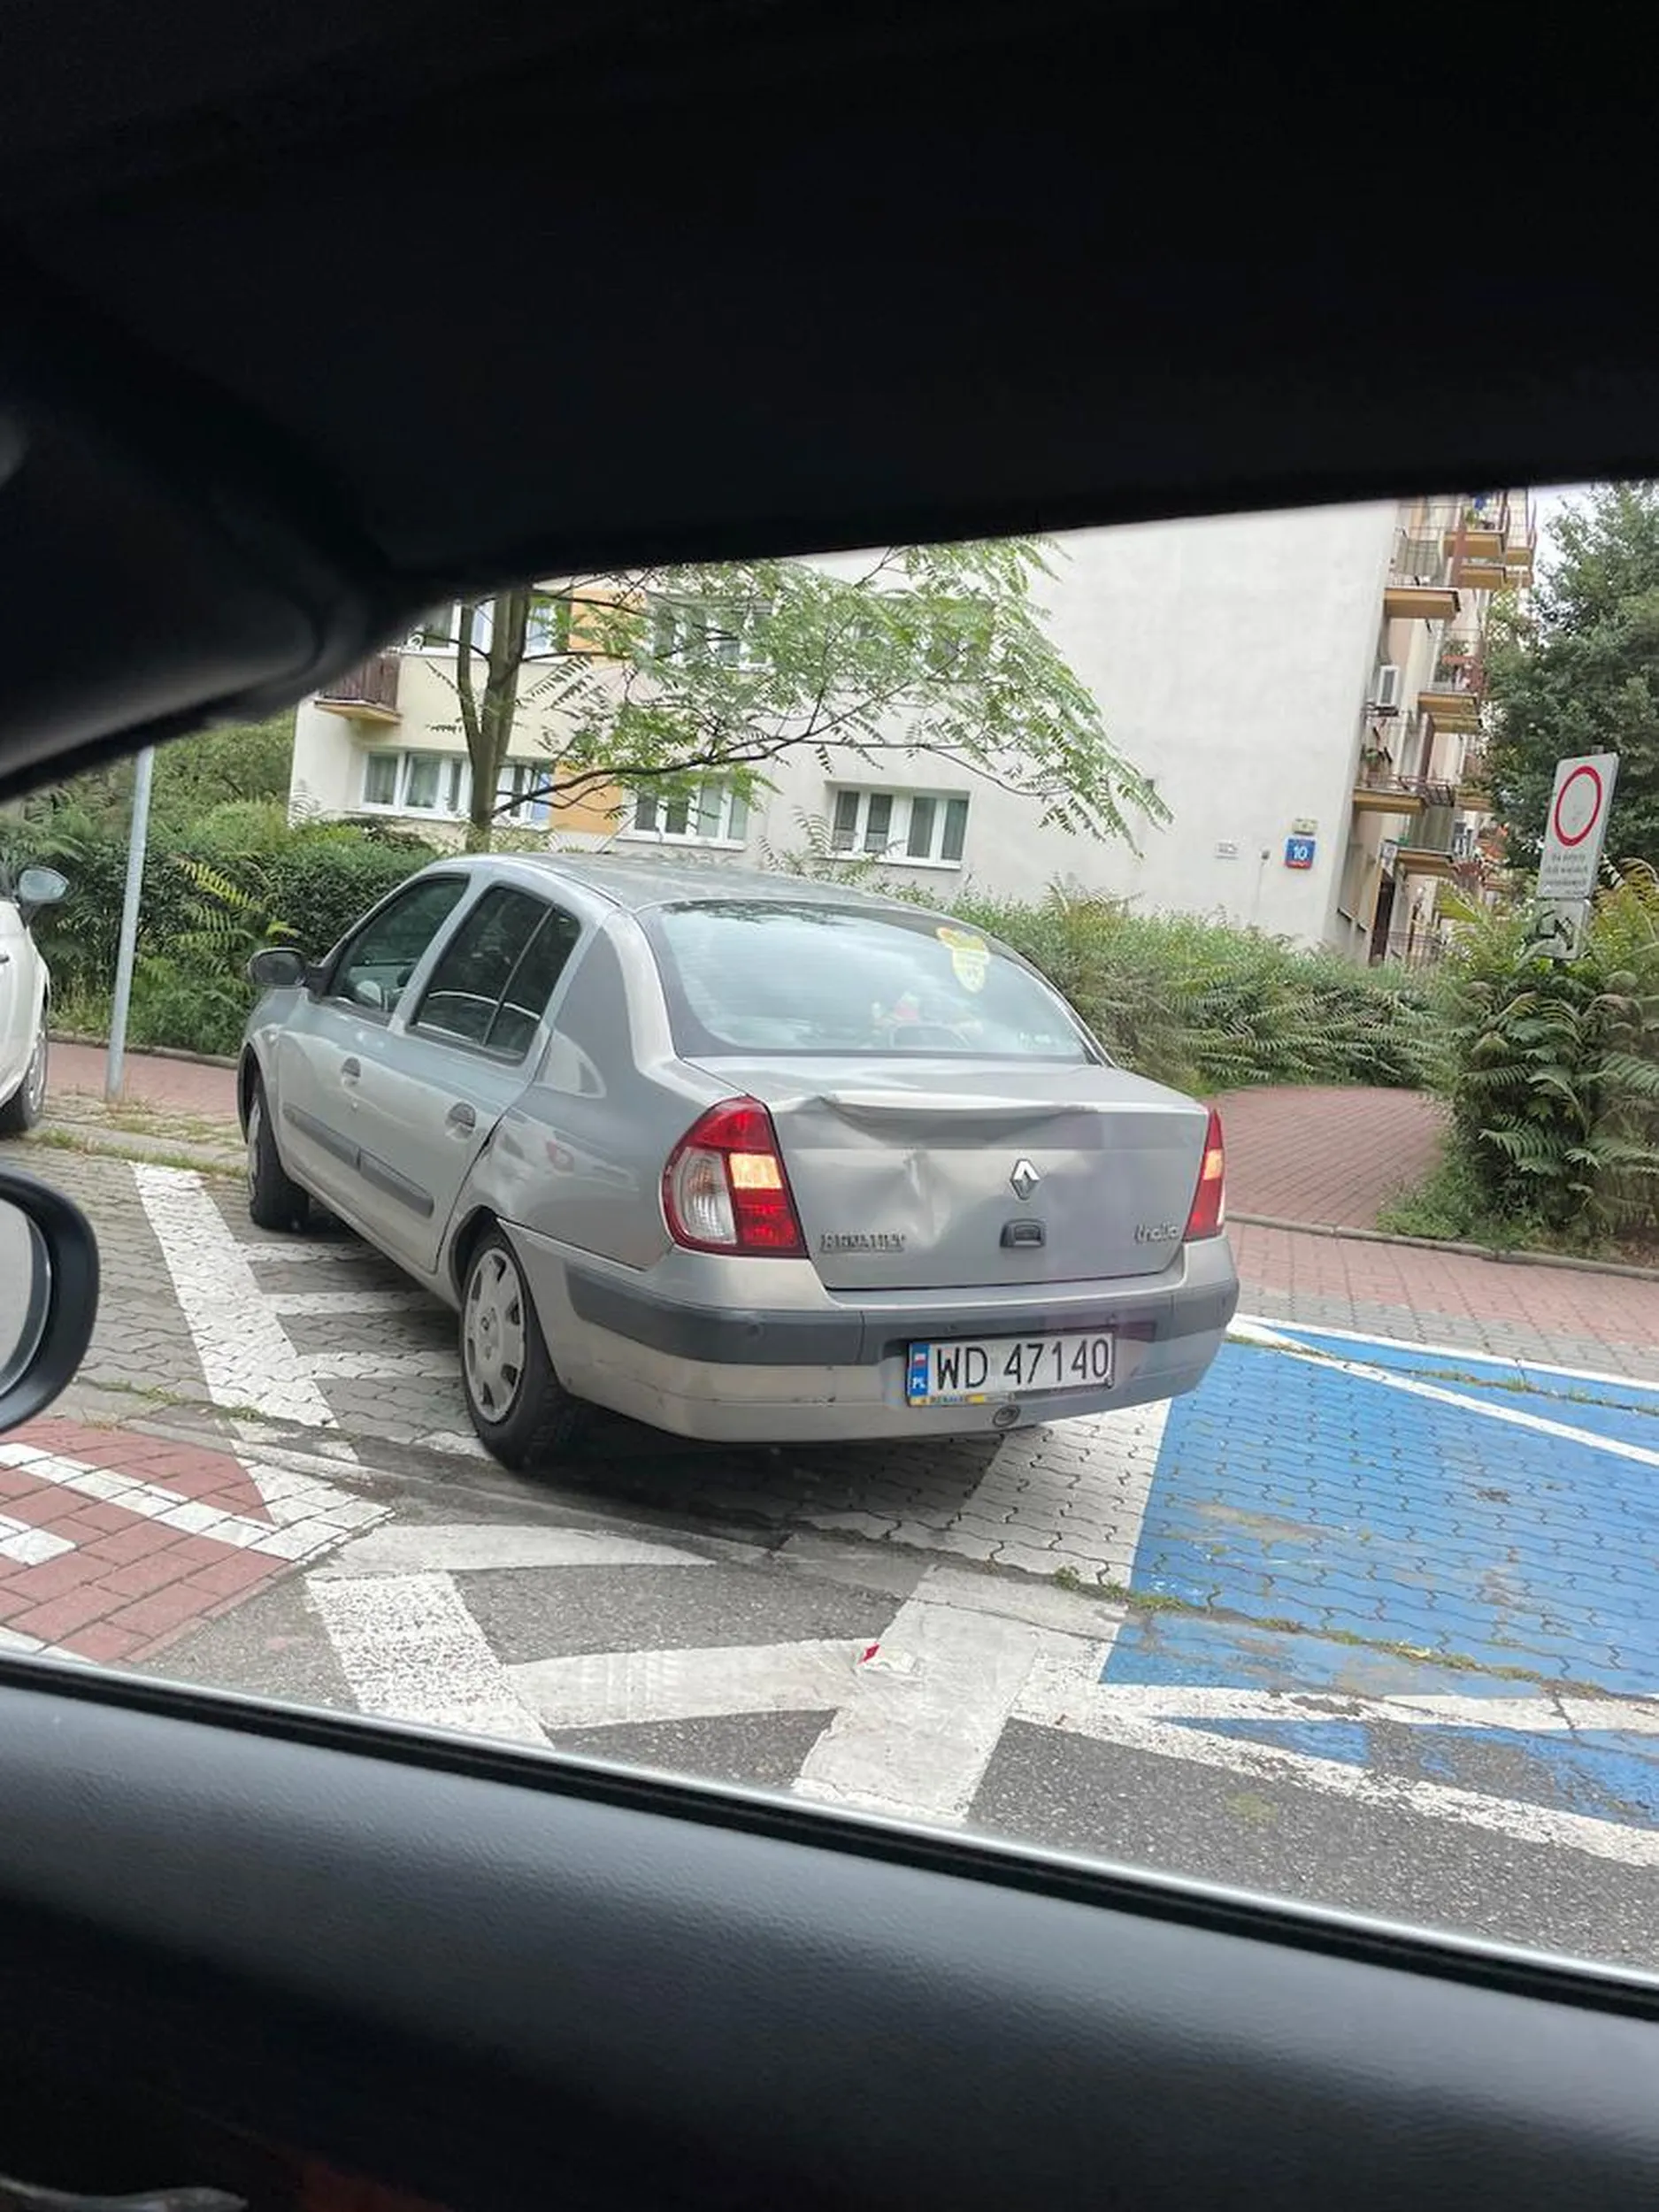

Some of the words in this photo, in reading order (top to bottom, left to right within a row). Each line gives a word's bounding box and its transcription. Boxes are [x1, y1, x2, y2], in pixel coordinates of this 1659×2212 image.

[1294, 844, 1309, 860] 10
[936, 1346, 988, 1391] WD
[1003, 1338, 1110, 1386] 47140
